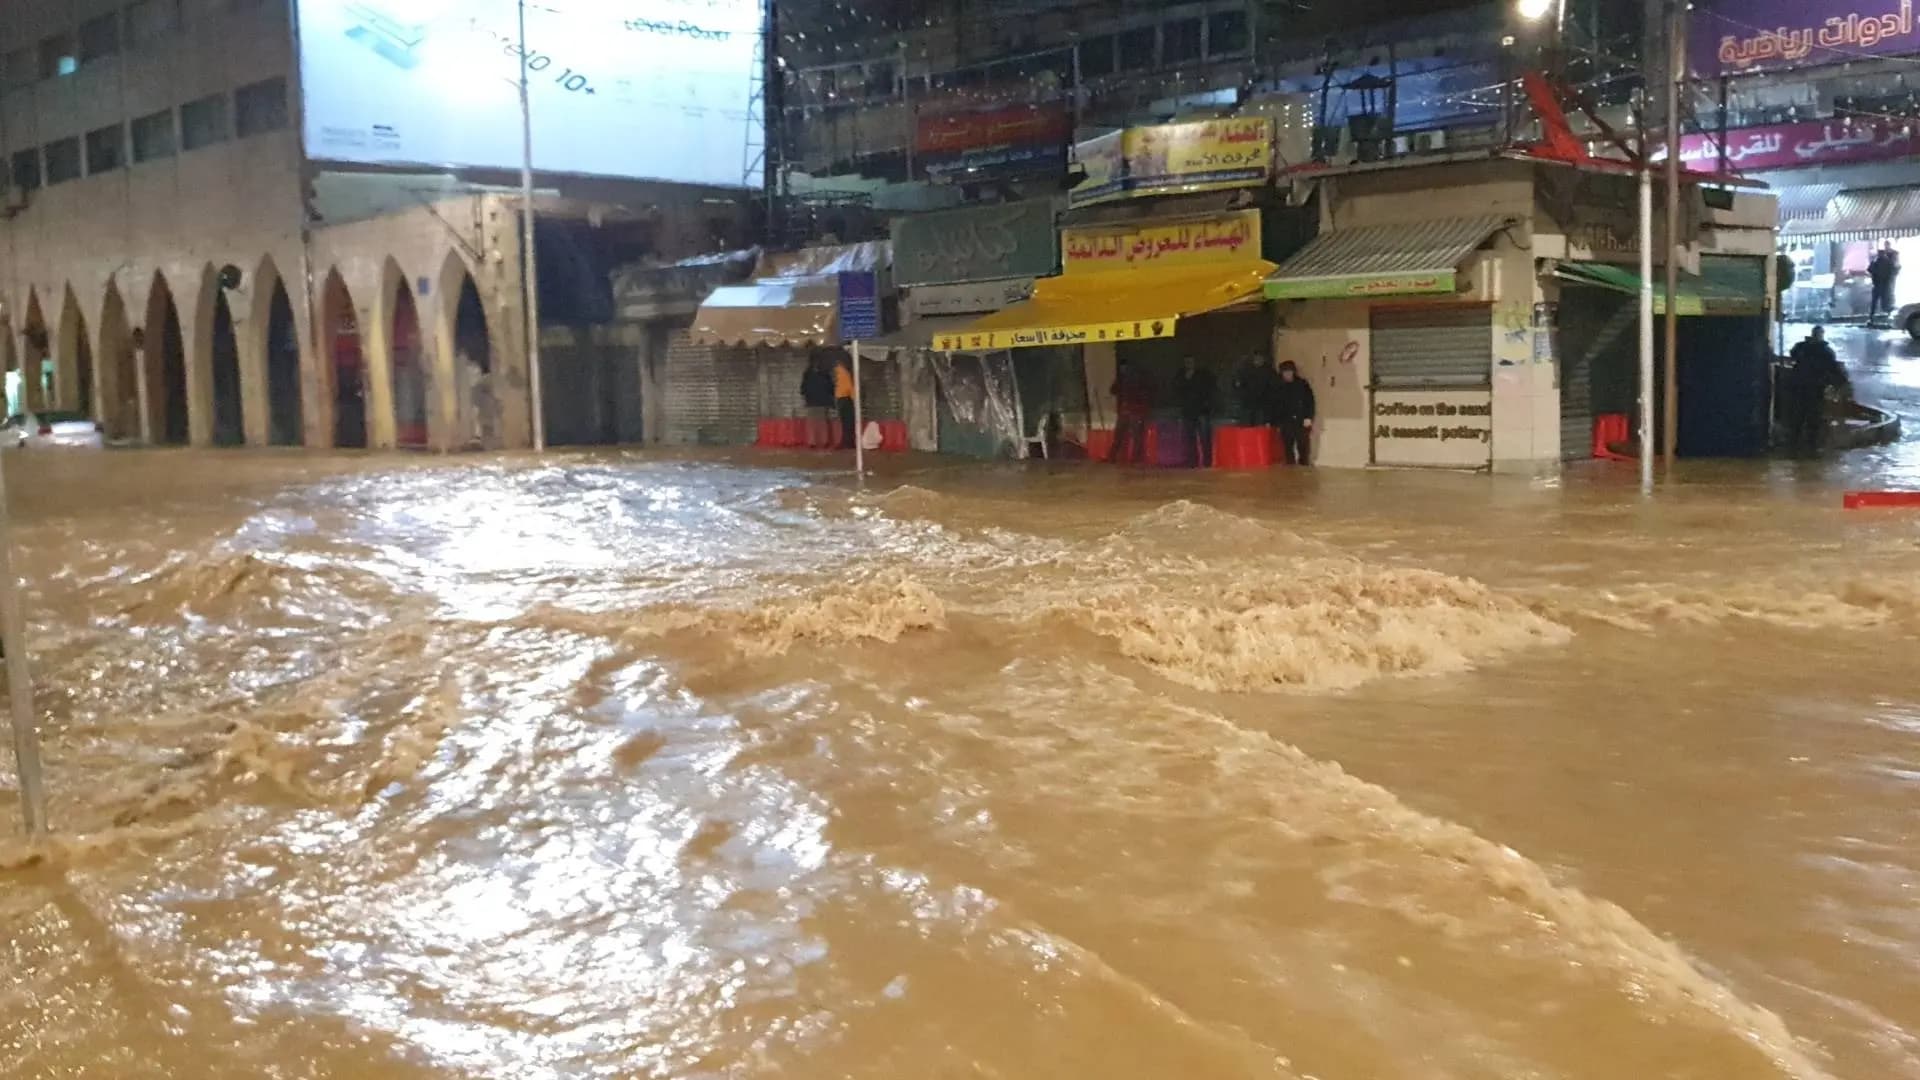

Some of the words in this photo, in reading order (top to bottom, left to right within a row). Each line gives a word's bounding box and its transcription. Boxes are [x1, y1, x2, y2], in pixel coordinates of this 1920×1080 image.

[1819, 0, 1912, 46] أدوات
[1719, 26, 1813, 67] رياضية
[1376, 402, 1418, 416] Coffee
[1435, 402, 1457, 416] the
